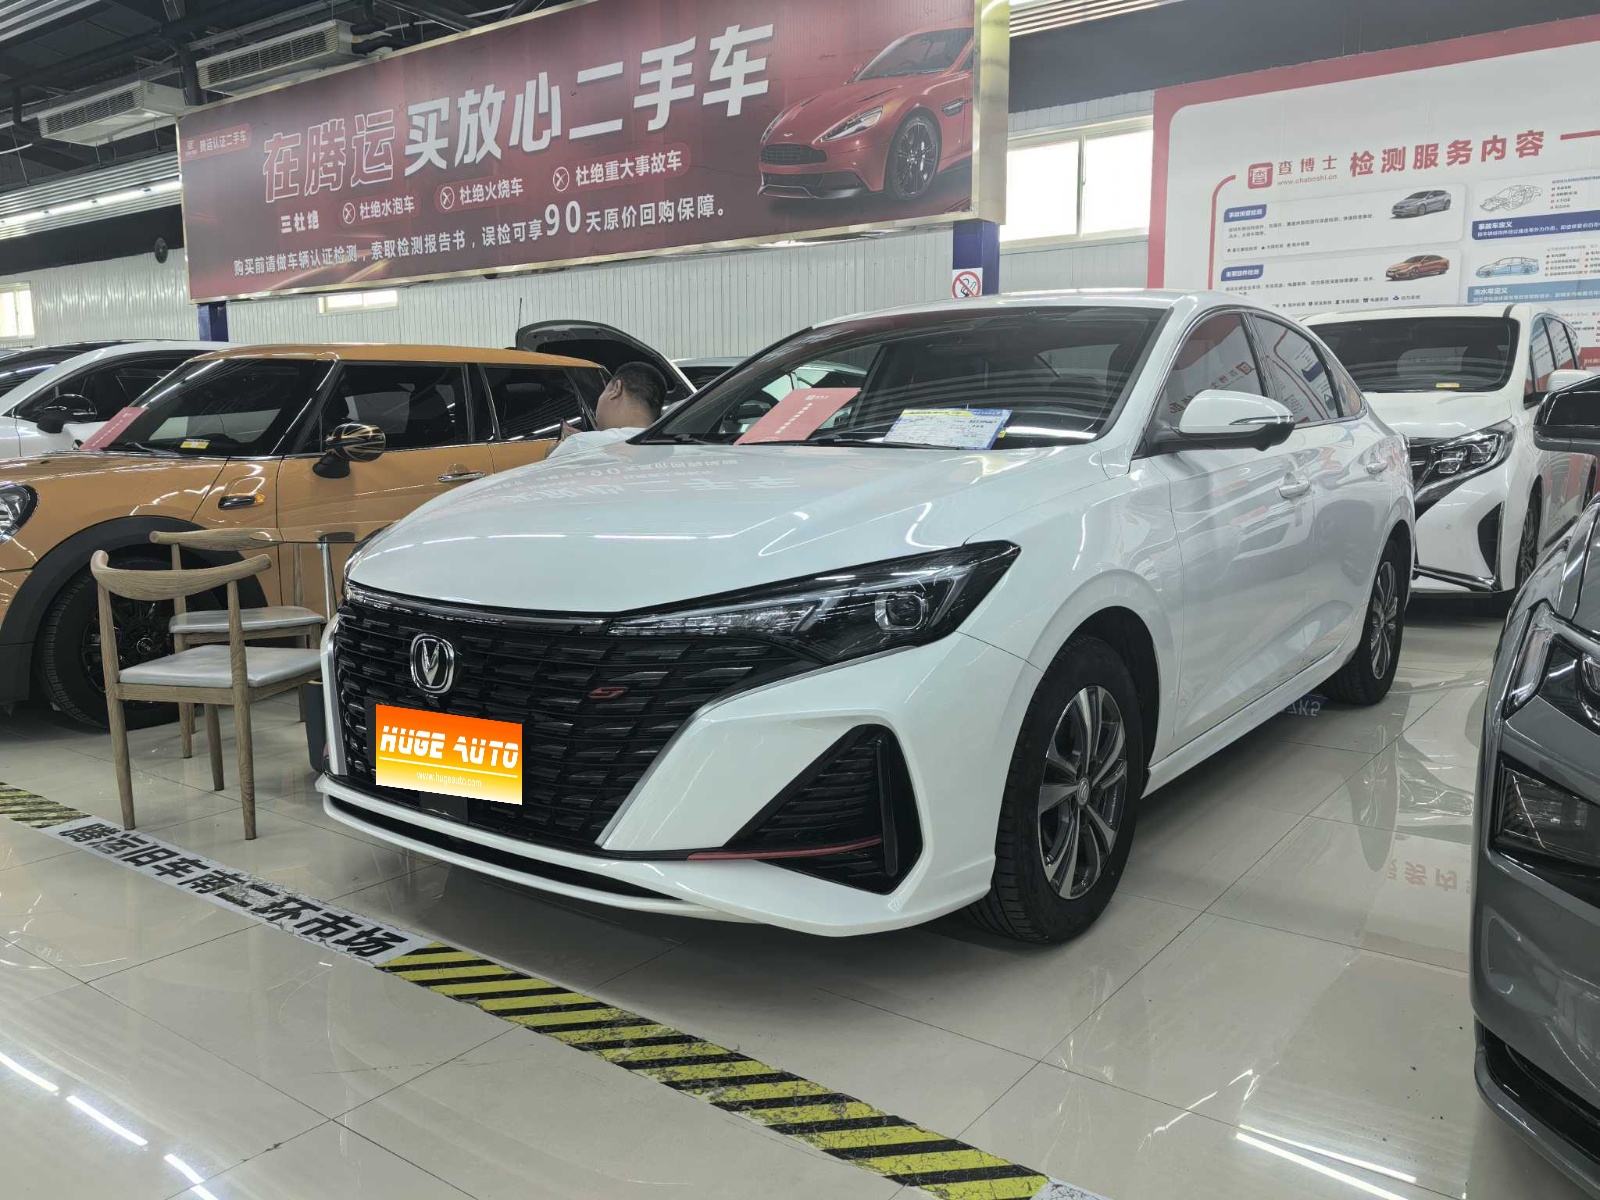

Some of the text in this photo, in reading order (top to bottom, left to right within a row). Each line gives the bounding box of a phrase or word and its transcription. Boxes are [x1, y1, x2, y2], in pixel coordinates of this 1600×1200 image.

[1278, 155, 1337, 176] 查博士
[1349, 129, 1545, 178] 检测服务内容
[575, 149, 682, 188] 杜绝重大事故车
[1277, 174, 1337, 187] www.chaboshi.cn
[459, 177, 524, 206] 杜绝火烧车
[359, 194, 415, 220] 杜绝水泡车
[280, 210, 320, 235] 三杜绝
